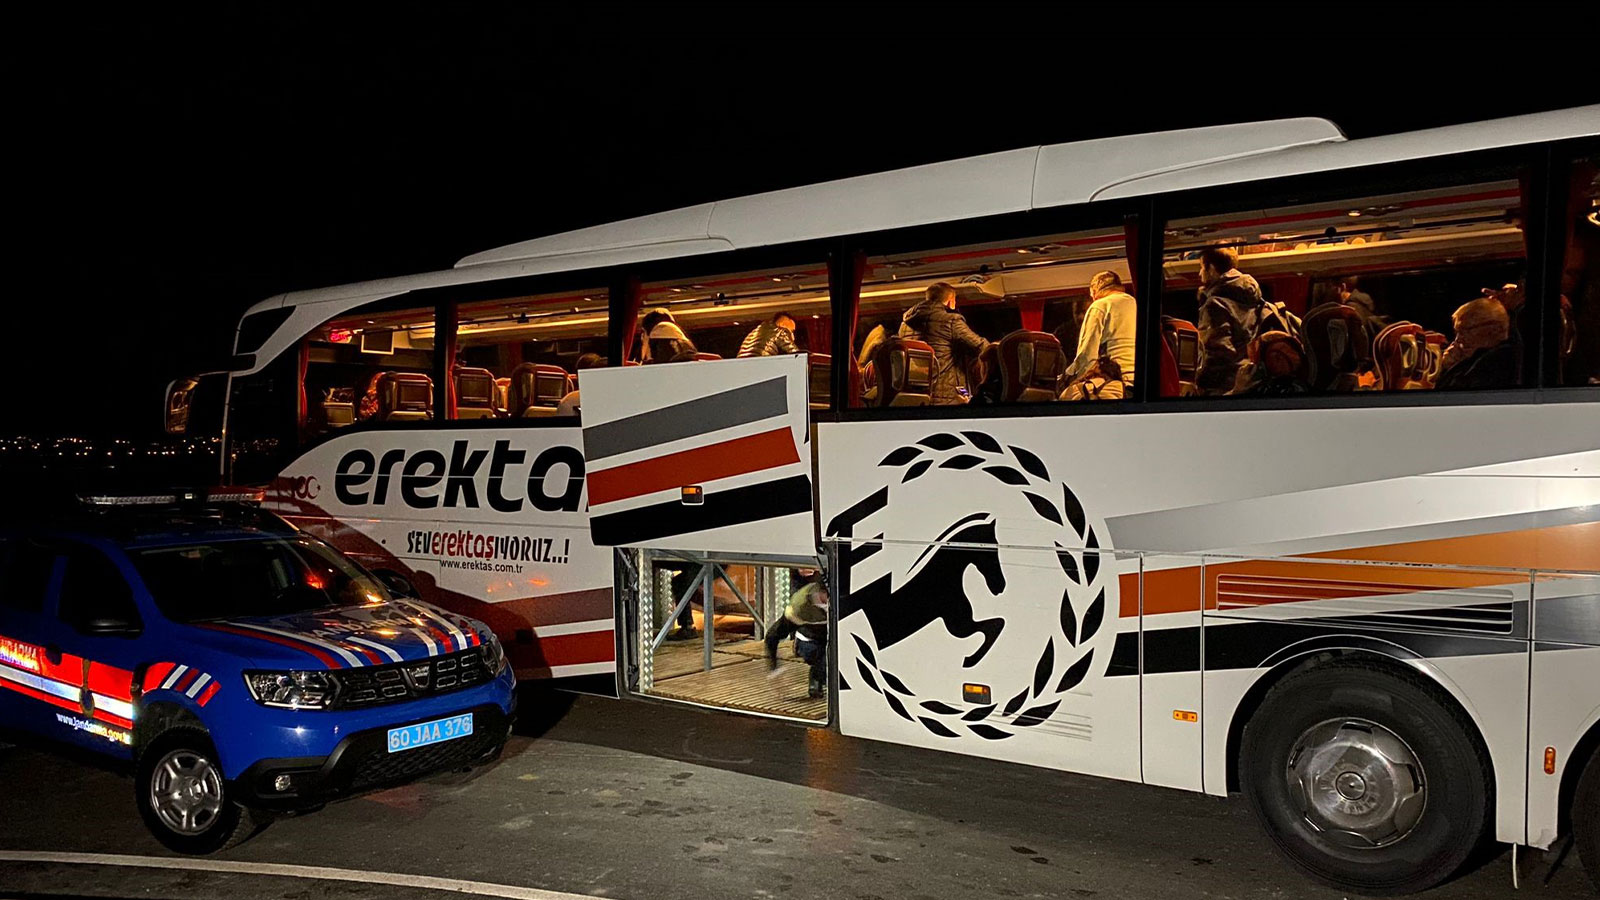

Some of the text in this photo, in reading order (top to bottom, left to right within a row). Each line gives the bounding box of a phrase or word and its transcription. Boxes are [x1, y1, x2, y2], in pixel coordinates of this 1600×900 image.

[335, 440, 588, 512] erekta
[440, 559, 523, 573] www.erektas.com.tr
[390, 716, 471, 748] 60 JAA 376
